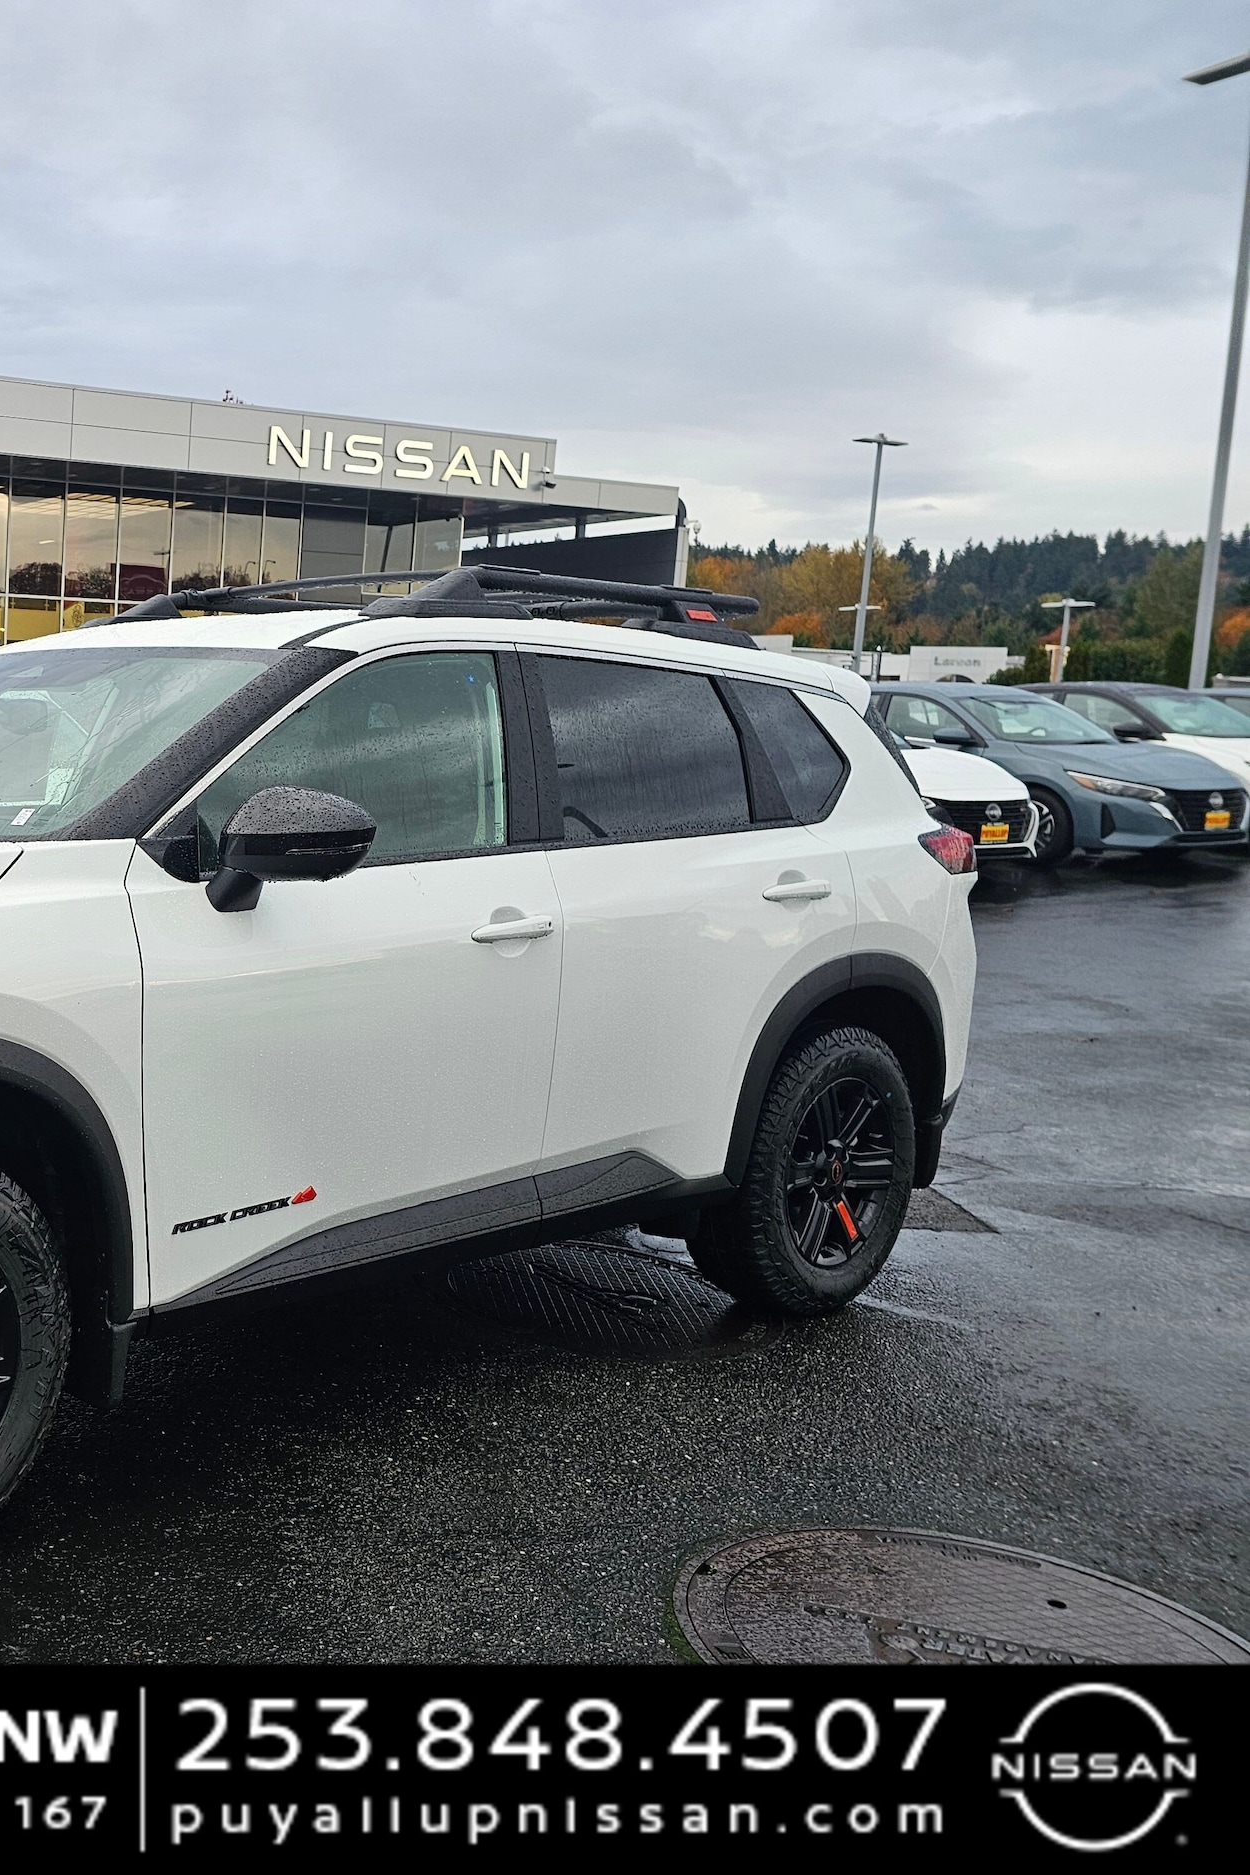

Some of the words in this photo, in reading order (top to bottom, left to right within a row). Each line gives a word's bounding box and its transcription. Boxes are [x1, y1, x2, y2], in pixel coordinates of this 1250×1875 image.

[268, 425, 530, 489] NISSAN
[171, 1212, 228, 1235] ROCK
[229, 1196, 292, 1222] CREEK
